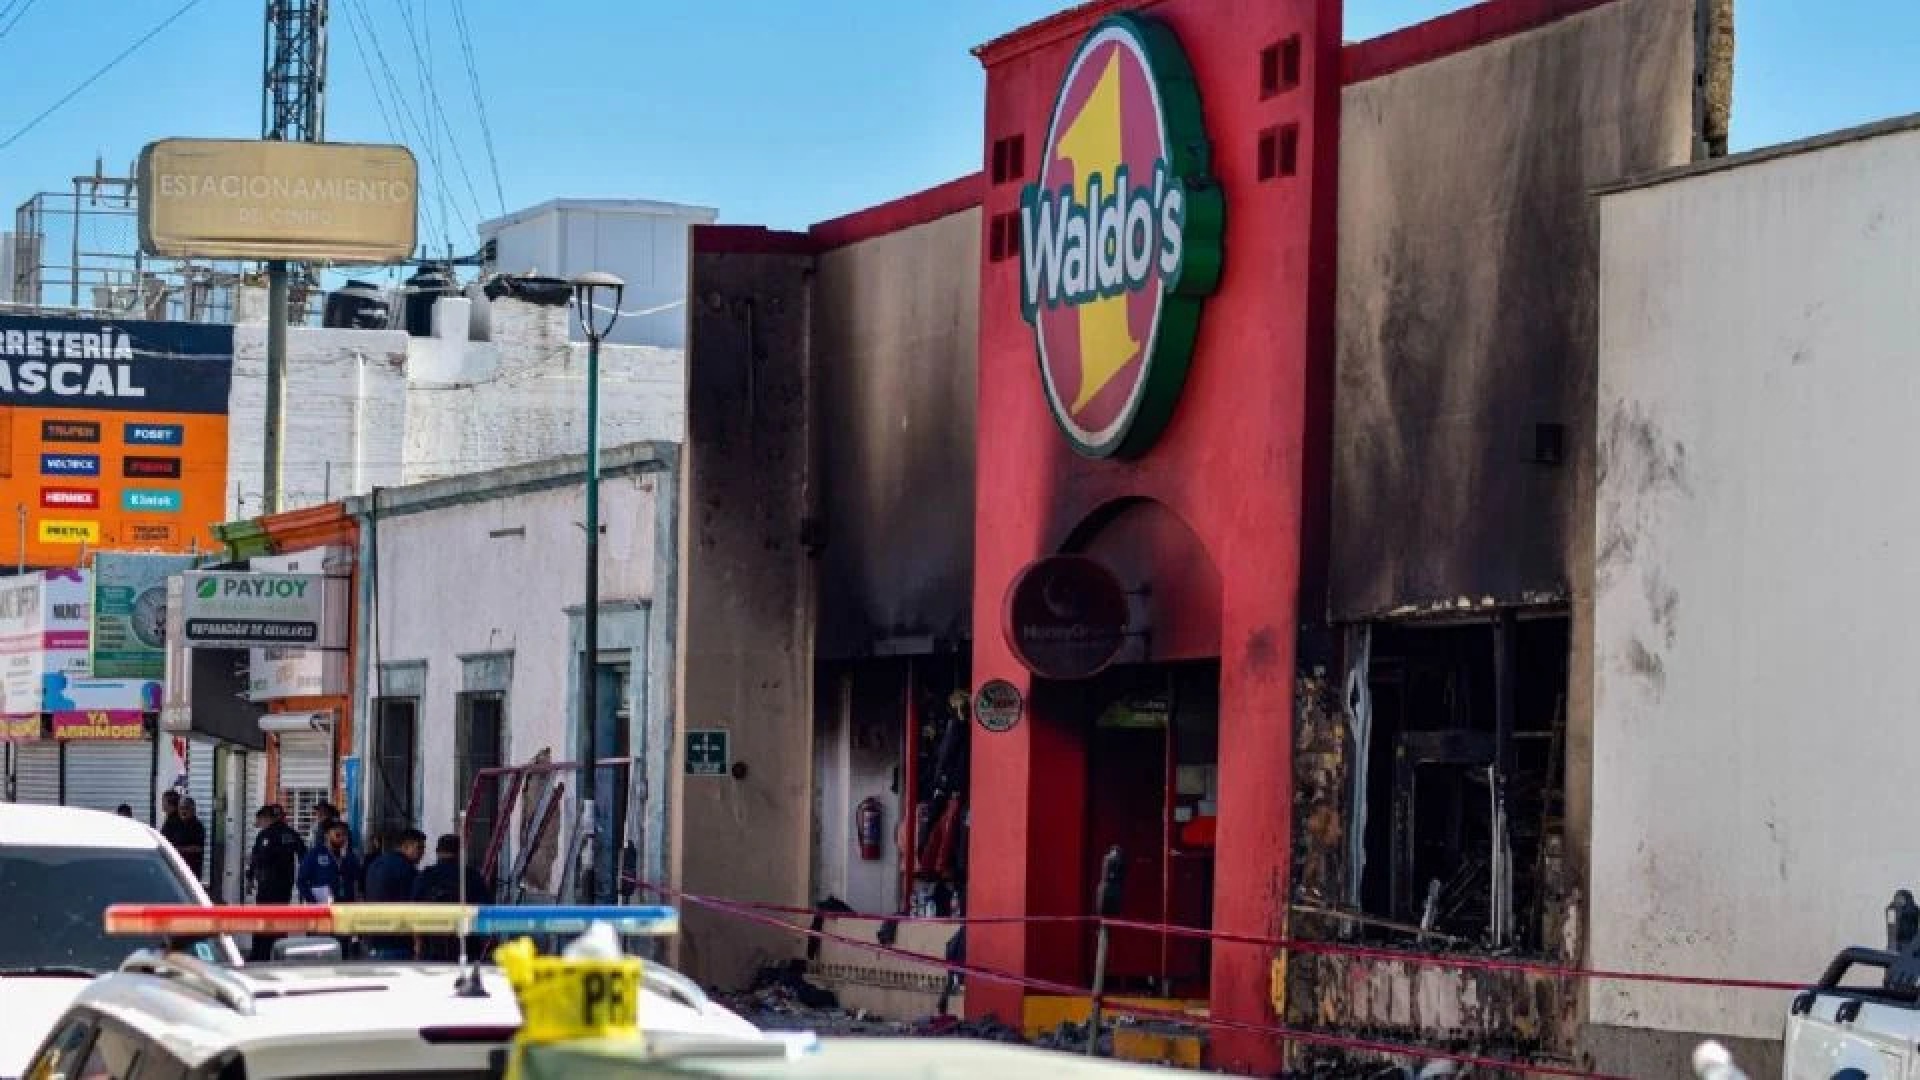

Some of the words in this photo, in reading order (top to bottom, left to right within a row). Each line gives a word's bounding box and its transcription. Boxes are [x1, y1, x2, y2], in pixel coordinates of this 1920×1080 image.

[160, 174, 409, 202] ESTACIONAMIENTO
[1022, 168, 1183, 305] Waldo's
[0, 326, 133, 359] RETERÍA
[224, 577, 308, 598] PAYJOY
[87, 711, 108, 725] YA
[55, 724, 141, 737] ABRIMOS
